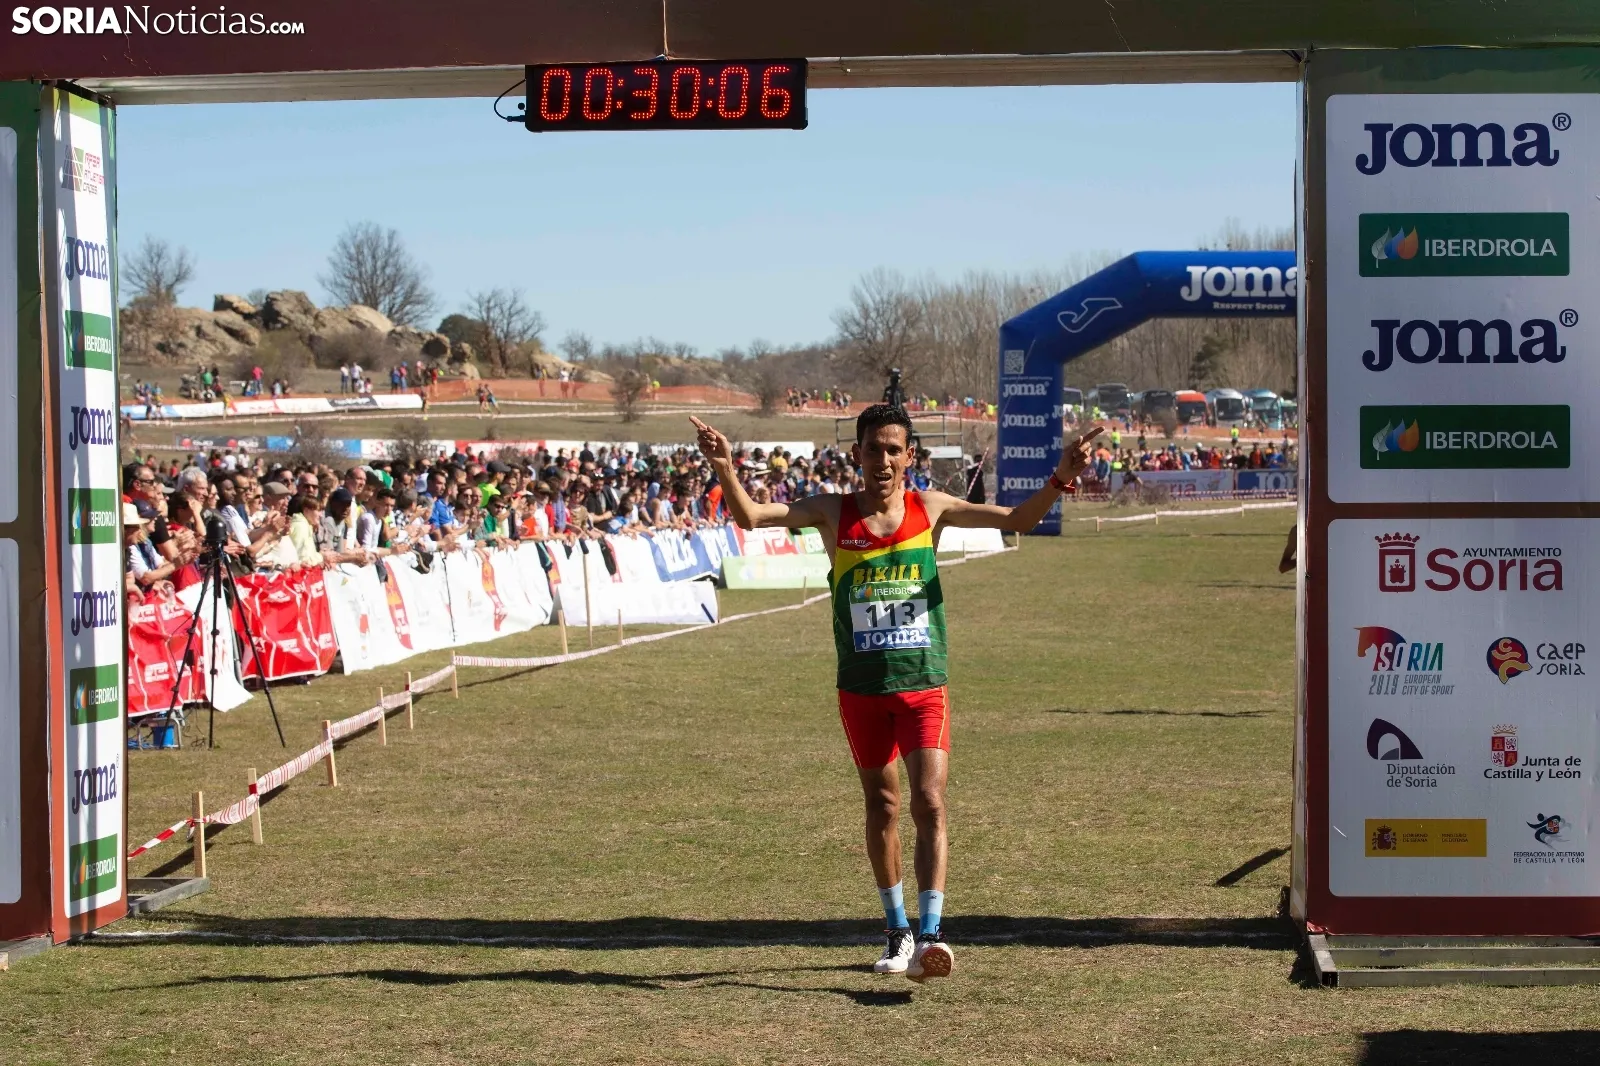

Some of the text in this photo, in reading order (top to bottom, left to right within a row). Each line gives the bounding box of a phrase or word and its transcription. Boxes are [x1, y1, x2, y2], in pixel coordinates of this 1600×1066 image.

[540, 66, 791, 121] 00:30:06
[1425, 238, 1558, 257] IBERDROLA
[1425, 431, 1558, 449] IBERDROLA
[1462, 547, 1562, 557] AYUNTAMIENTO
[1425, 548, 1563, 591] Soria
[866, 602, 916, 629] 113
[1372, 642, 1444, 671] SORIA
[1368, 674, 1400, 695] 2019
[1404, 674, 1442, 684] EUROPEAN
[1401, 685, 1455, 695] CITY OF SPORT
[1387, 762, 1456, 776] Diputación
[1521, 755, 1581, 767] Junta de
[1387, 776, 1437, 788] de Soria
[1483, 767, 1581, 782] Castilla y León
